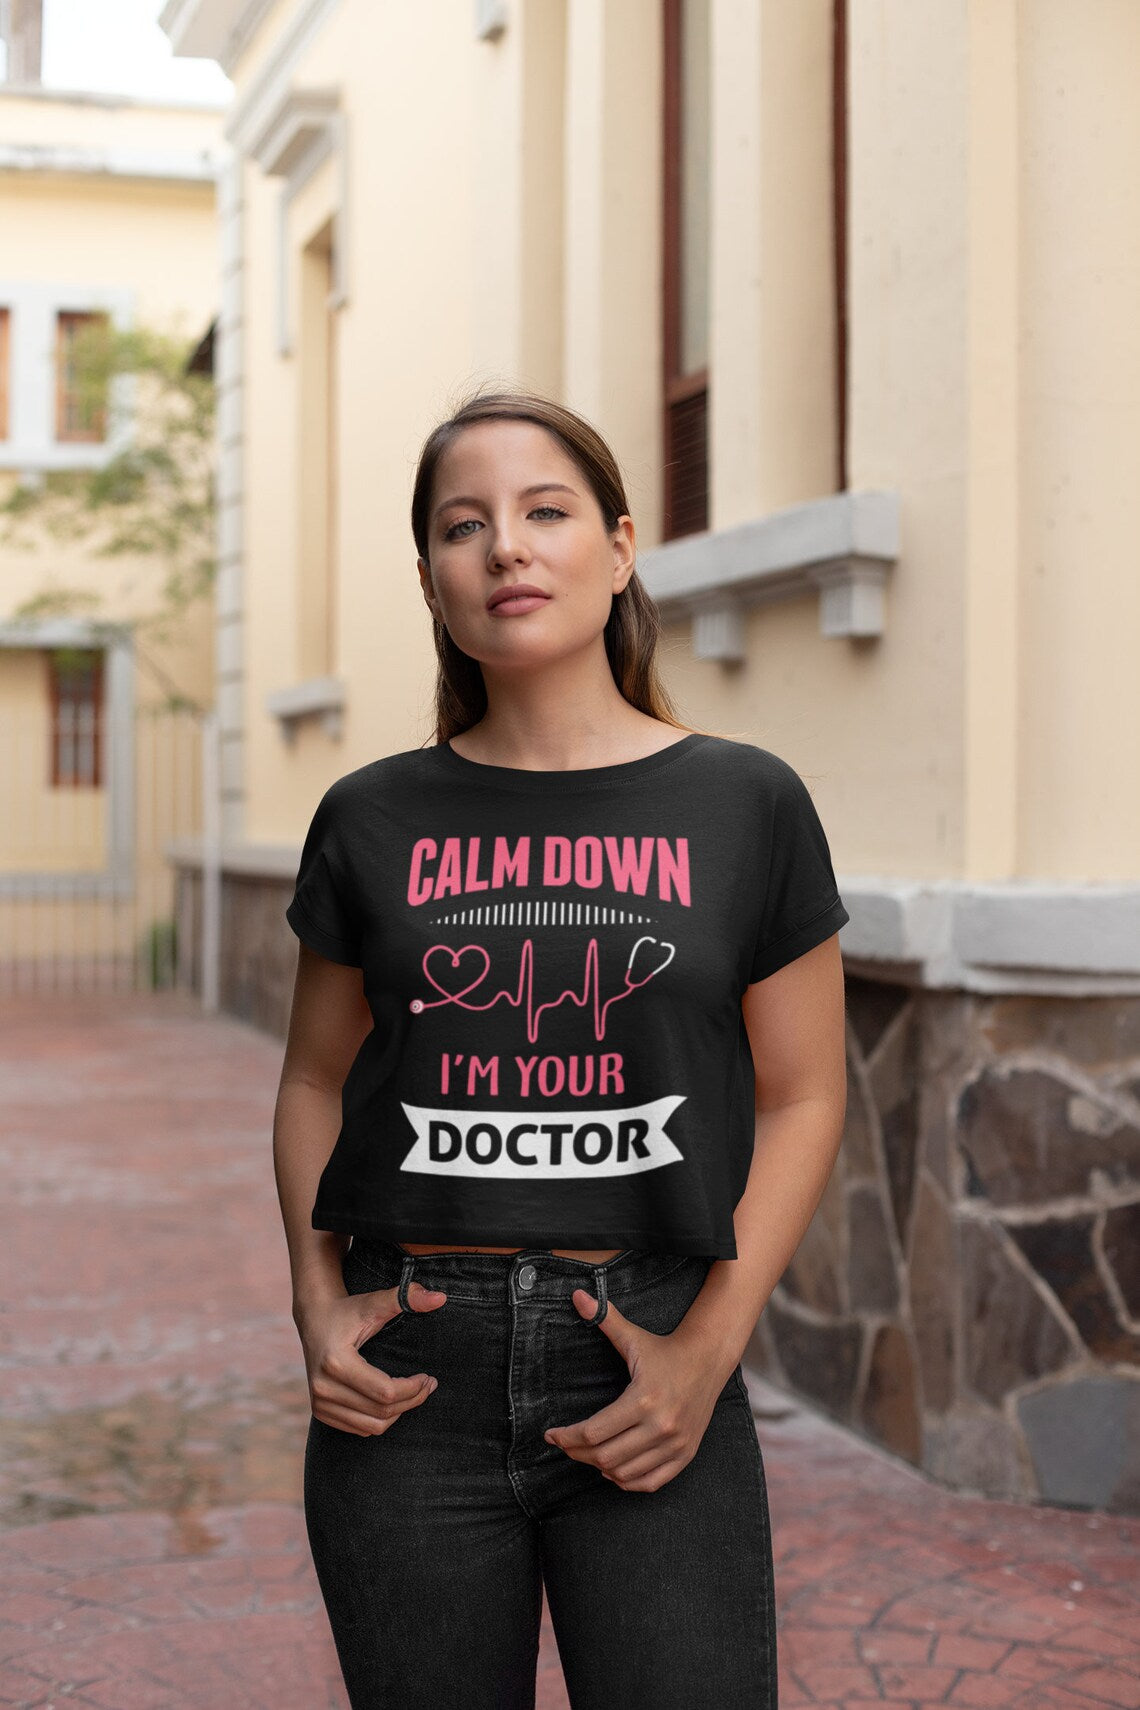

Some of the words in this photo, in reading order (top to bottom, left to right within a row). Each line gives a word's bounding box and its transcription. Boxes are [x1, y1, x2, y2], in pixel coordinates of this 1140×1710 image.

[407, 836, 531, 907] CALM
[543, 836, 691, 907] DOWN
[441, 1053, 499, 1096] I'M
[515, 1052, 625, 1097] YOUR
[428, 1118, 651, 1166] DOCTOR
